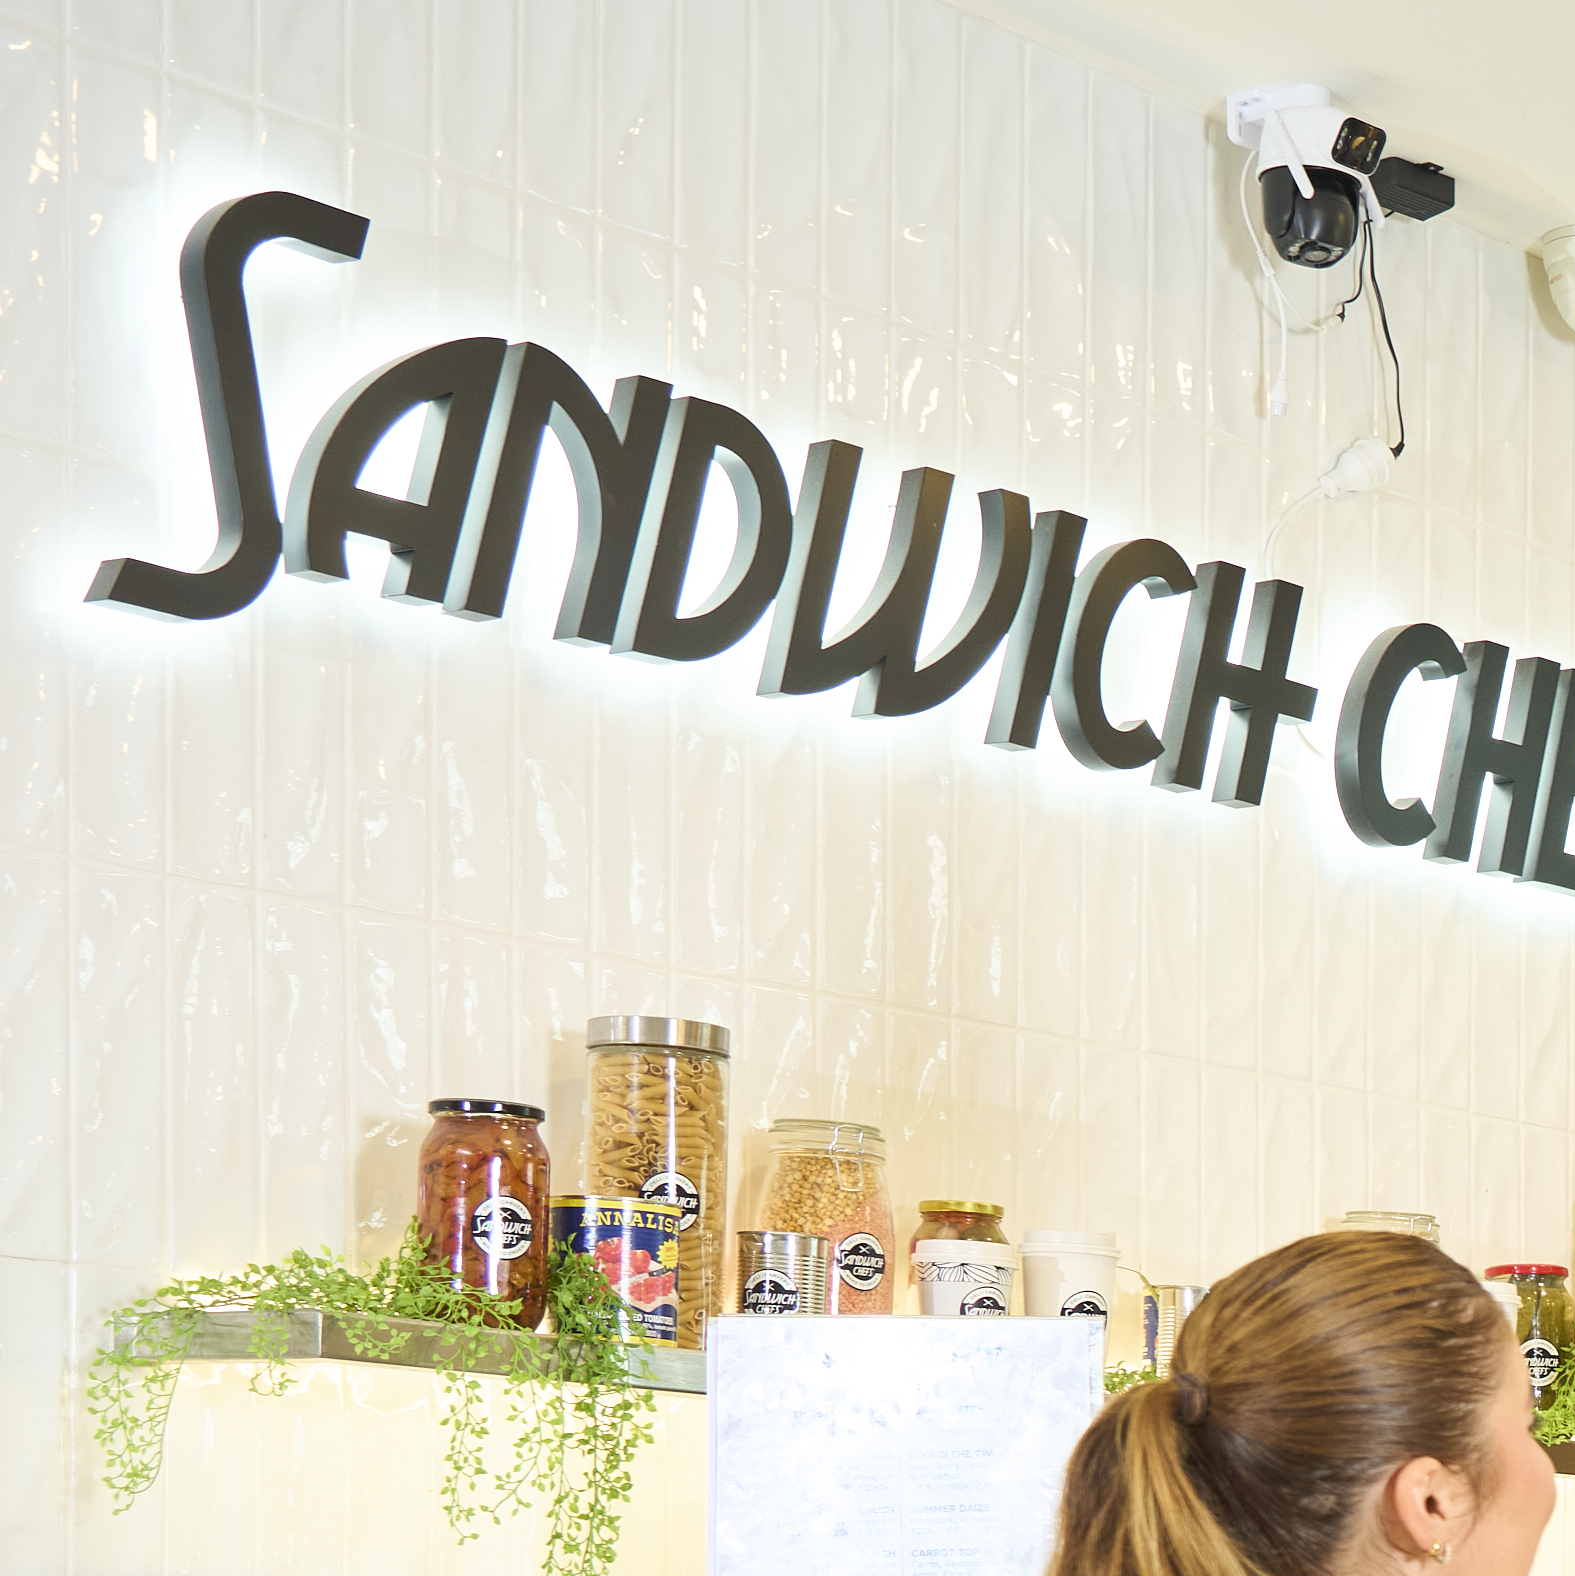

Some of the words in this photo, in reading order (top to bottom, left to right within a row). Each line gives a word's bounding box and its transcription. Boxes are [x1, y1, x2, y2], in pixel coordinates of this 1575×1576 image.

[84, 190, 1317, 808] SANDWICH
[580, 1210, 680, 1234] ANNALISA
[838, 1251, 885, 1268] SANDWICH
[852, 1266, 875, 1277] CHEFS
